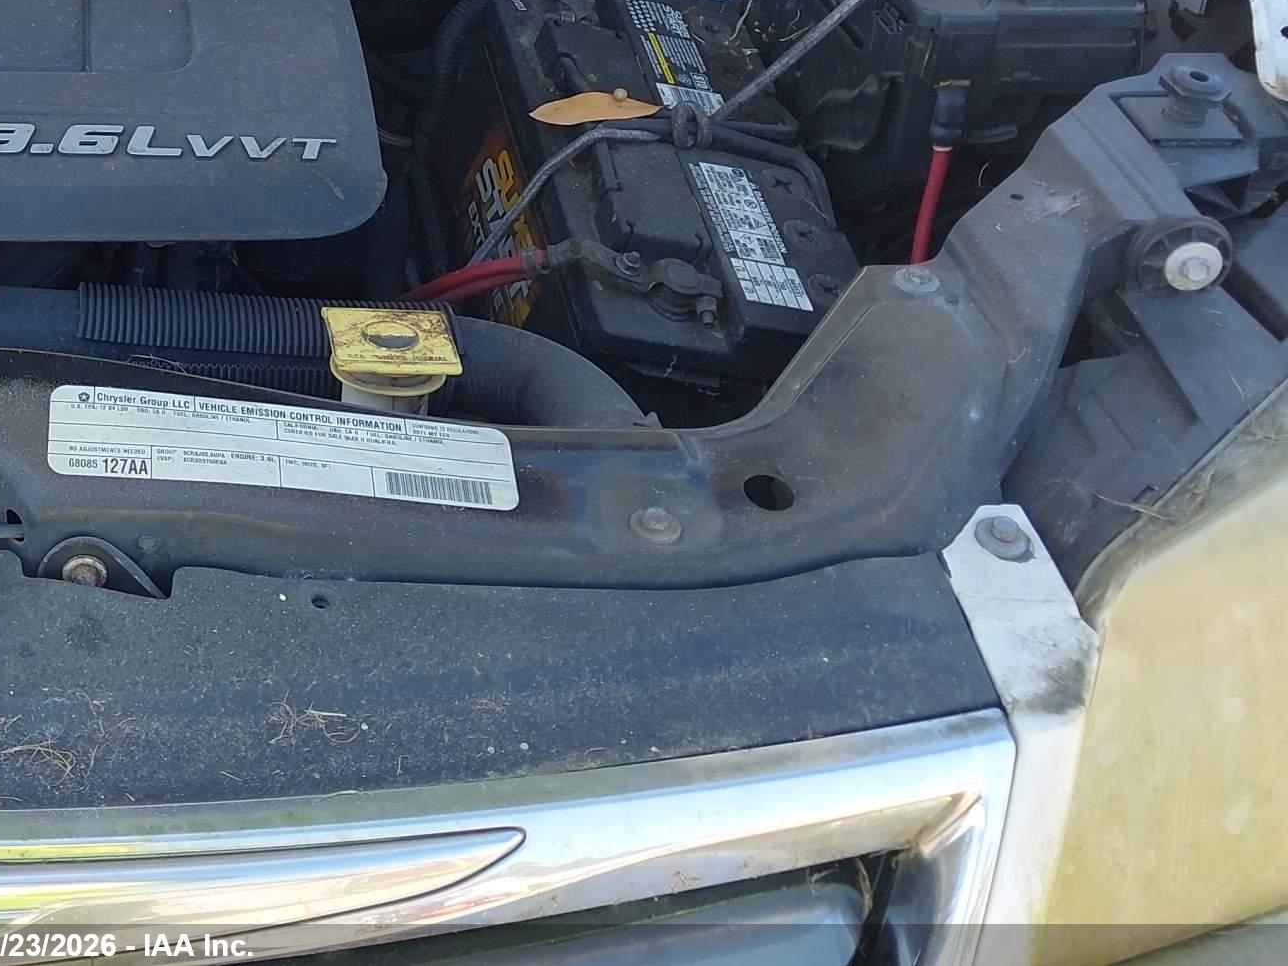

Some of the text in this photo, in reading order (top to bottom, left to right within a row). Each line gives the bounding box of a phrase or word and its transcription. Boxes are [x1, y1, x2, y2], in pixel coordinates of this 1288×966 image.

[186, 133, 338, 161] VVT
[97, 392, 190, 410] Chrysler Group LLC
[199, 402, 402, 432] VEHICLE EMISSION CONTROL INFORMATION
[68, 458, 149, 475] 68085 127AA
